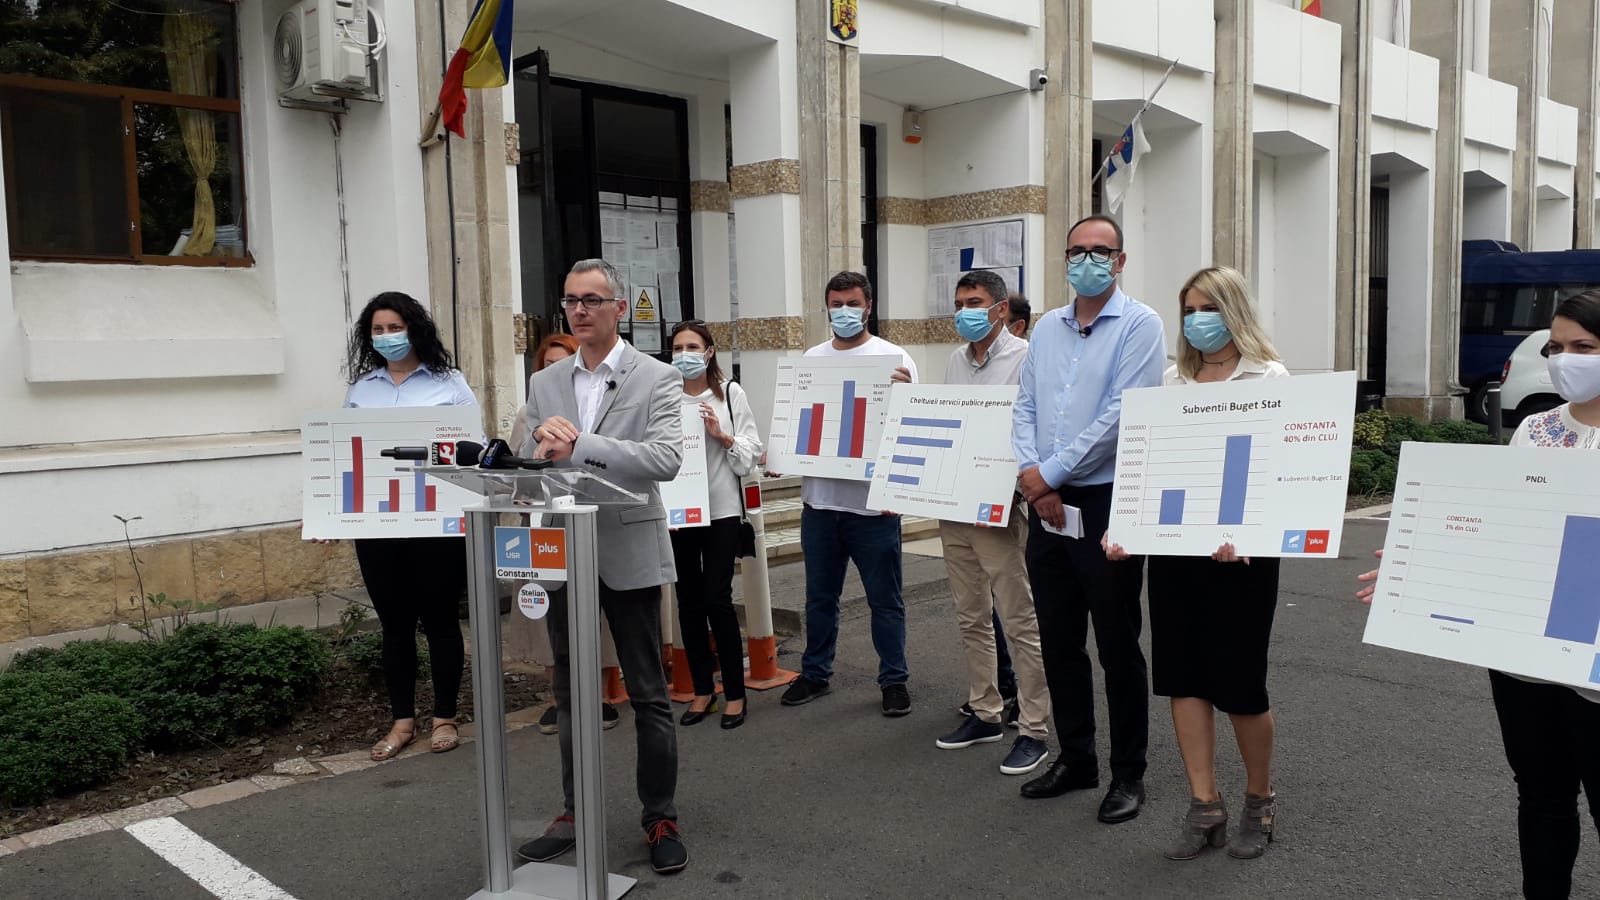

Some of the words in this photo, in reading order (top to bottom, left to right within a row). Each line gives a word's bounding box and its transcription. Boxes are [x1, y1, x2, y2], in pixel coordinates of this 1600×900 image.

[909, 396, 938, 405] Cheltuieli
[939, 397, 960, 406] servicii
[961, 397, 984, 408] publice
[984, 399, 1013, 408] generale
[1182, 402, 1227, 414] Subventii
[1229, 401, 1259, 413] Buget
[1260, 399, 1282, 409] Stat
[1284, 421, 1337, 431] CONSTANTA
[1283, 435, 1300, 443] 40%
[1302, 434, 1316, 442] din
[1318, 433, 1338, 441] CLUJ
[1525, 475, 1548, 483] PNDL
[1446, 515, 1482, 524] CONSTANTA
[1465, 525, 1479, 533] CLUJ
[1222, 532, 1234, 540] Cluj
[520, 589, 546, 598] Stelian
